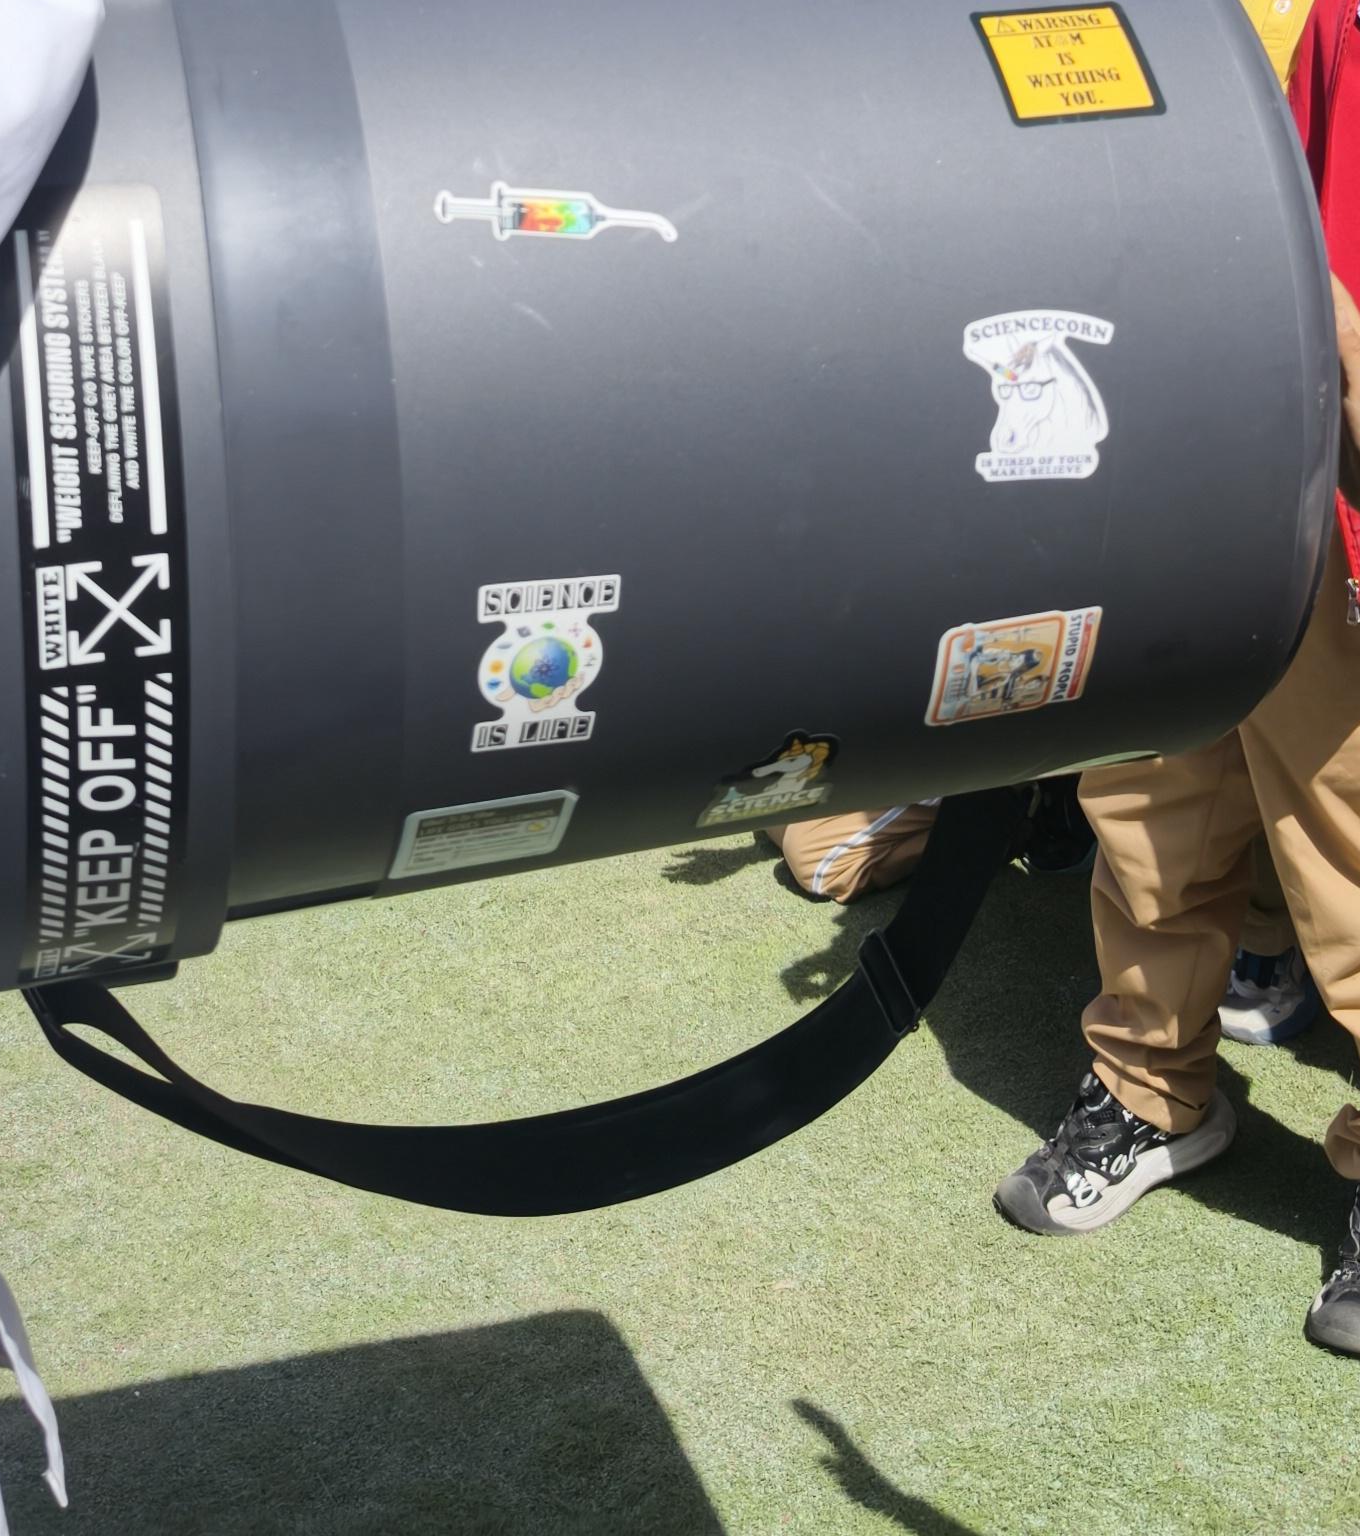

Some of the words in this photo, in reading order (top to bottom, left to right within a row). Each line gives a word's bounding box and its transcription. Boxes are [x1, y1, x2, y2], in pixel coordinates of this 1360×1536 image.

[1017, 12, 1102, 31] WARNING
[1056, 51, 1075, 67] IS
[1027, 67, 1122, 88] WATCHING
[75, 279, 95, 343] STICKERS
[95, 281, 113, 344] BETWEEN
[970, 317, 1109, 343] SCIENCECORN
[80, 345, 97, 378] TAPE
[99, 346, 115, 382] AREA
[117, 337, 134, 384] COLOR
[44, 332, 78, 440] SECURING
[102, 382, 119, 422] GREY
[120, 386, 136, 413] THE
[104, 423, 119, 450] THE
[123, 415, 139, 458] WHITE
[125, 460, 140, 490] AND
[484, 579, 617, 617] SCIENCE
[41, 571, 62, 663] WHITE
[476, 723, 508, 749] IS
[518, 715, 592, 744] LIFE
